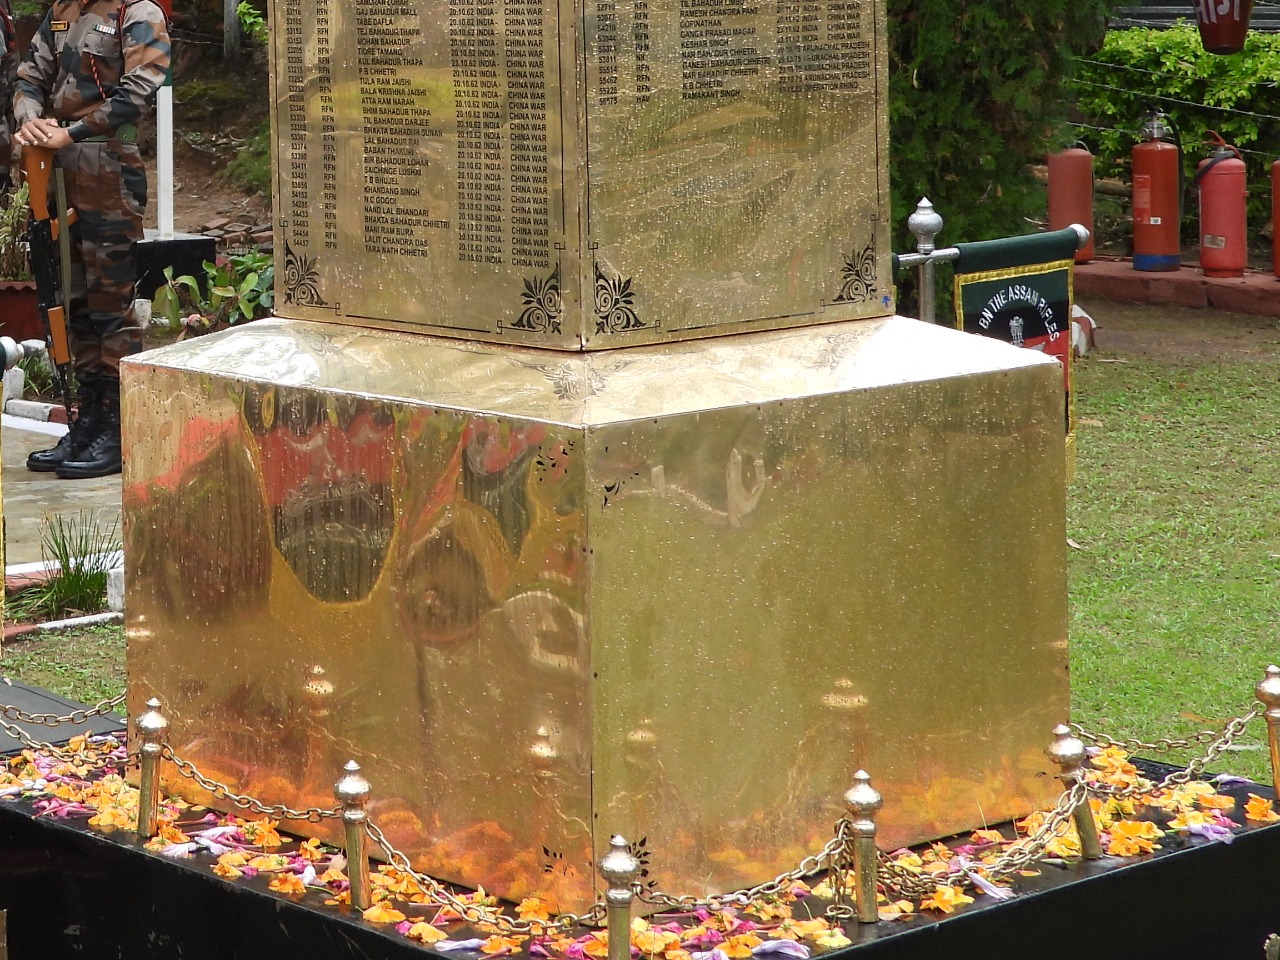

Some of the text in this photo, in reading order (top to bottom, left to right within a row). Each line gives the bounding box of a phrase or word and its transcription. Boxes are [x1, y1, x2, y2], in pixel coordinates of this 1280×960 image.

[371, 57, 400, 66] BAHADUR
[402, 58, 423, 66] THAPA
[842, 70, 870, 79] PRADESH
[359, 77, 375, 85] TULA
[376, 77, 390, 85] RAM
[682, 90, 719, 100] RAMAKANT
[720, 89, 739, 97] SINGH
[361, 96, 414, 106] ATTA RAM NARAH
[363, 184, 419, 197] KHANDANG SINGH
[382, 206, 394, 215] LAL
[395, 207, 428, 218] BHANDARI
[381, 246, 397, 255] NATH
[399, 247, 427, 258] CHHETRI
[979, 284, 1060, 342] BN THE ASSAM RIFLES
